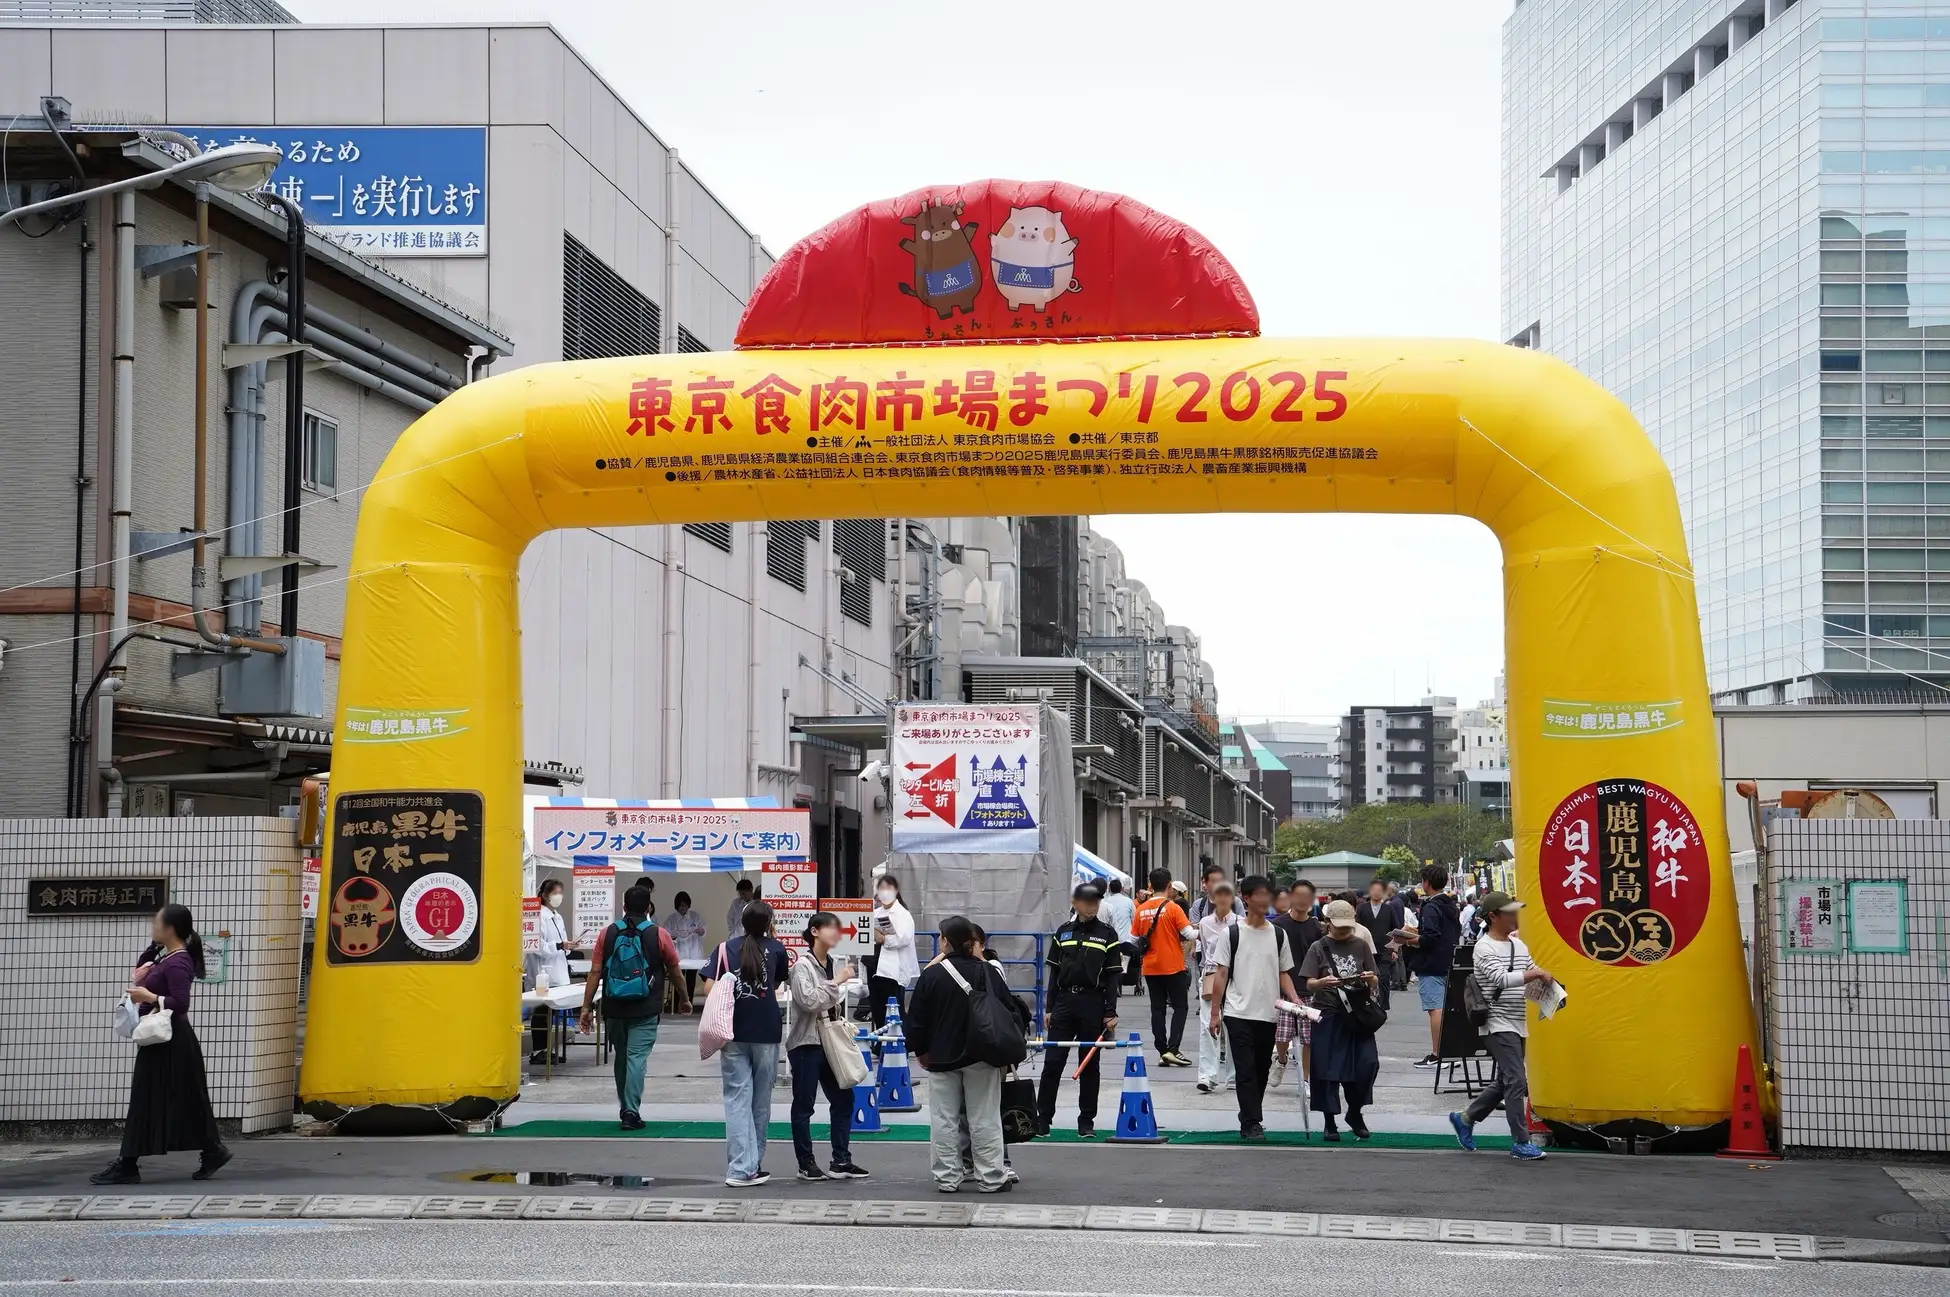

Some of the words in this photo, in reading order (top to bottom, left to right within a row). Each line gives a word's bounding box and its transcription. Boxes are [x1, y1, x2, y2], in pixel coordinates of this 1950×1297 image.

[625, 370, 1348, 437] 東京食肉市場まつり2025
[912, 711, 1021, 722] 東京食肉市場まつり2025
[901, 728, 1032, 739] ご来場ありがとうございます
[899, 778, 960, 793] センタービル会場
[621, 813, 727, 825] 東京食肉市場まつり2025
[1597, 784, 1625, 795] BEST
[1628, 785, 1669, 804] WAGYU
[1669, 801, 1681, 814] IN
[1679, 813, 1701, 846] JAPAN
[1605, 801, 1642, 904] 鹿児島
[1651, 819, 1689, 898] 和牛
[768, 863, 810, 872] 場内撮影禁止
[1562, 819, 1597, 909] 日本一
[39, 886, 156, 907] 食肉市場正門
[432, 891, 449, 900] 日本
[1817, 886, 1832, 925] 市場内
[343, 912, 378, 928] 黒牛
[428, 907, 450, 928] GI
[1798, 896, 1814, 948] 撮影禁止
[858, 915, 870, 944] 出口
